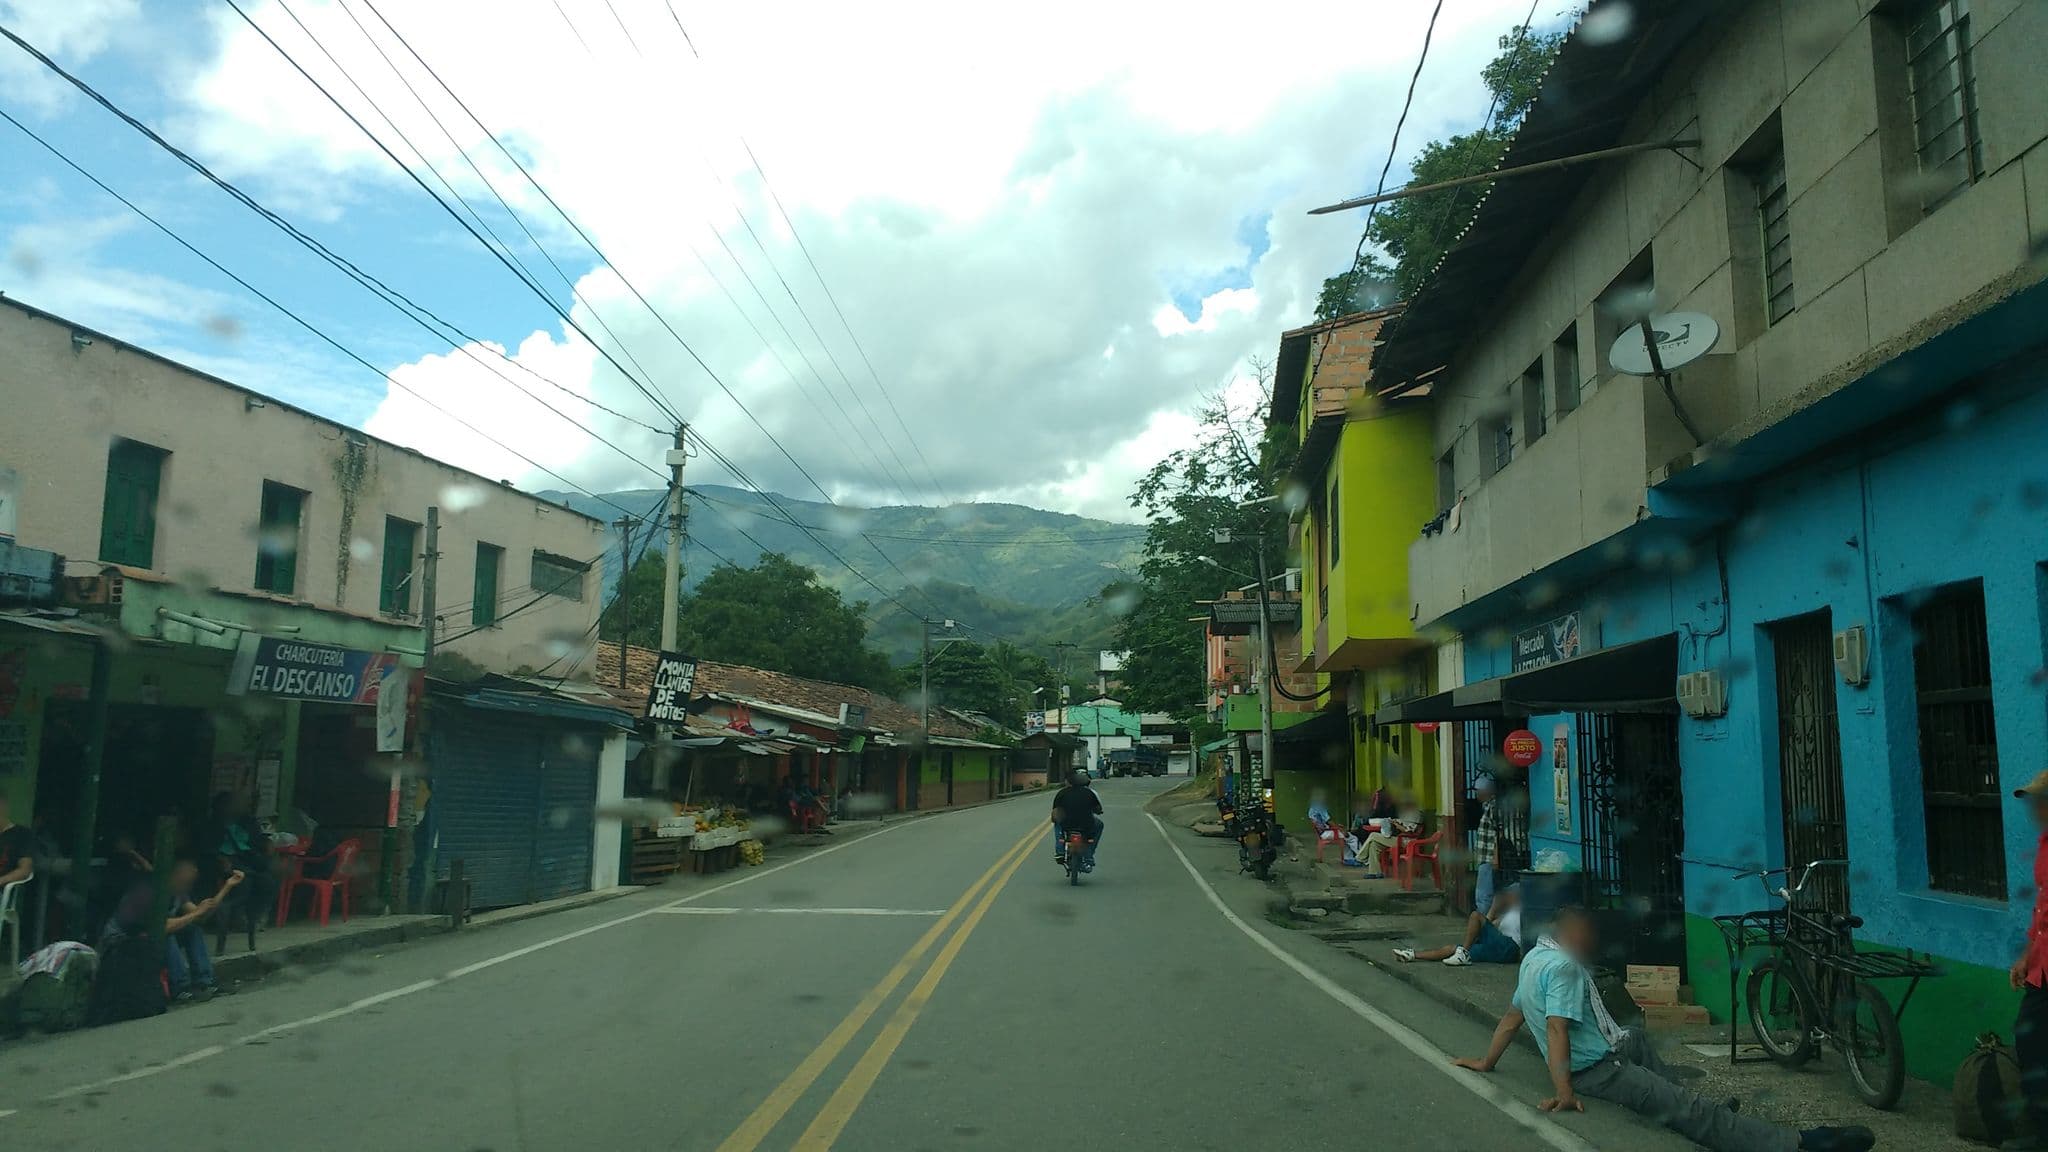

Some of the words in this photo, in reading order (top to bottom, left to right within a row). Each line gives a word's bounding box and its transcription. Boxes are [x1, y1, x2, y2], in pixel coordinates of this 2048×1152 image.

[1519, 630, 1544, 657] Mercado
[659, 659, 694, 677] MONTA
[250, 665, 269, 691] EL
[273, 667, 354, 698] DESCANSO
[654, 673, 692, 693] LLANTAS
[656, 689, 676, 705] DE
[649, 703, 686, 720] MOTOS
[1510, 744, 1536, 752] JUSTO
